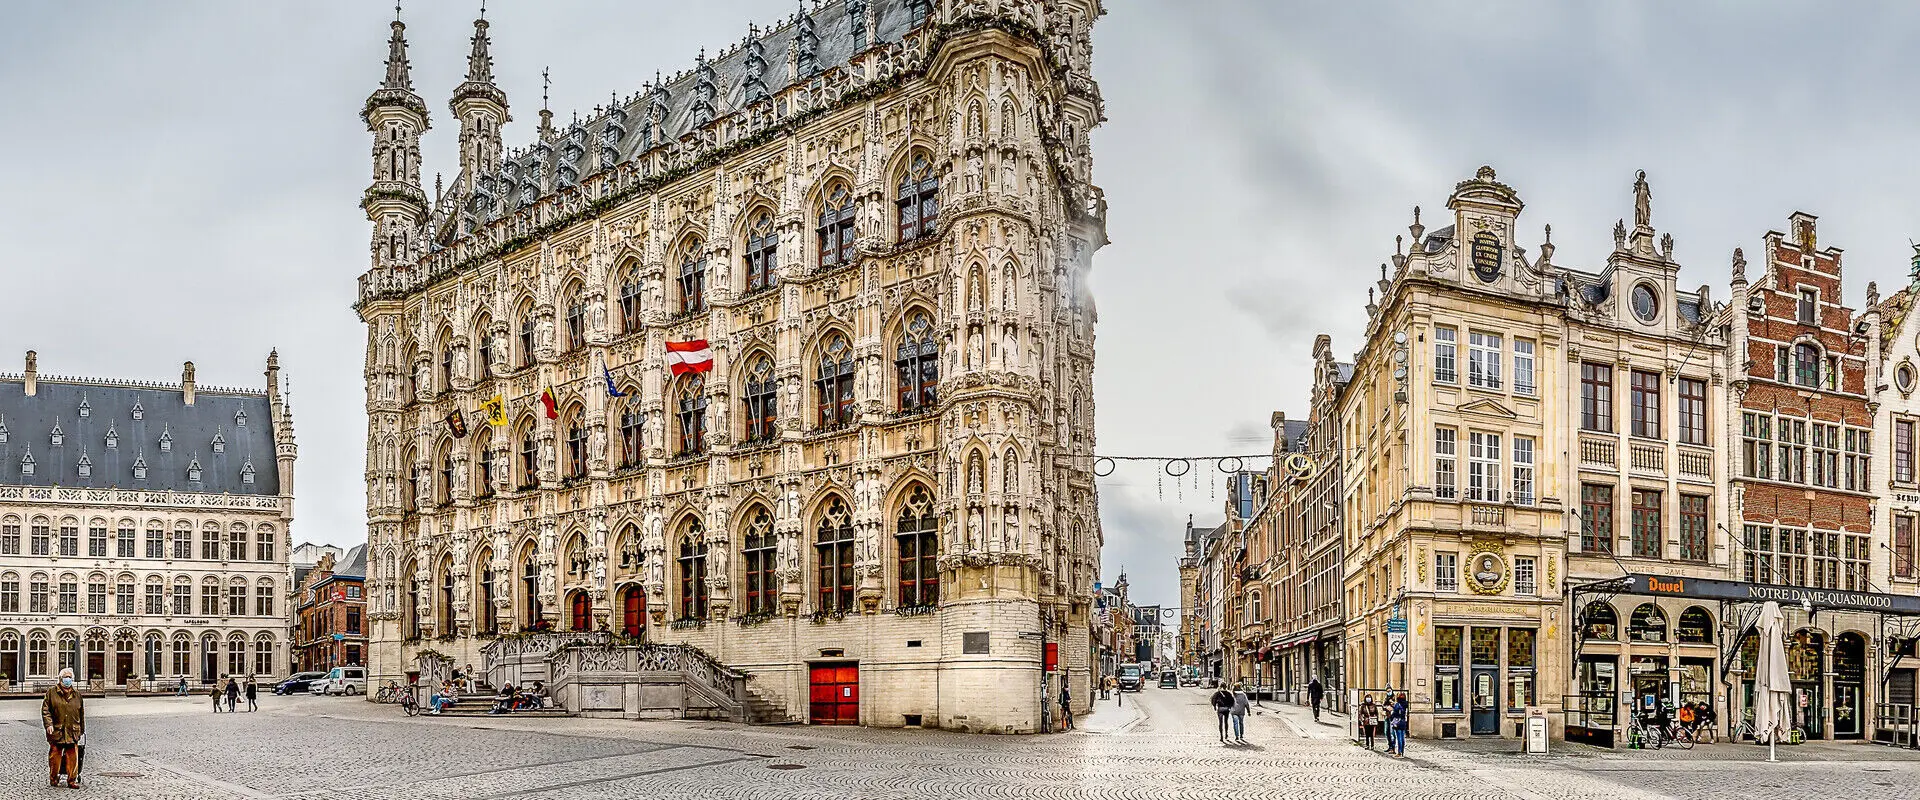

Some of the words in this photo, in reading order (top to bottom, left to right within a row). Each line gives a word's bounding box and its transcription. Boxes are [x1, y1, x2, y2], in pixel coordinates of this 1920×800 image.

[1664, 567, 1687, 576] DAME
[1648, 576, 1684, 593] Duvel
[1748, 586, 1790, 600] NOTRE
[1791, 590, 1891, 608] DAME-QUASIMODO
